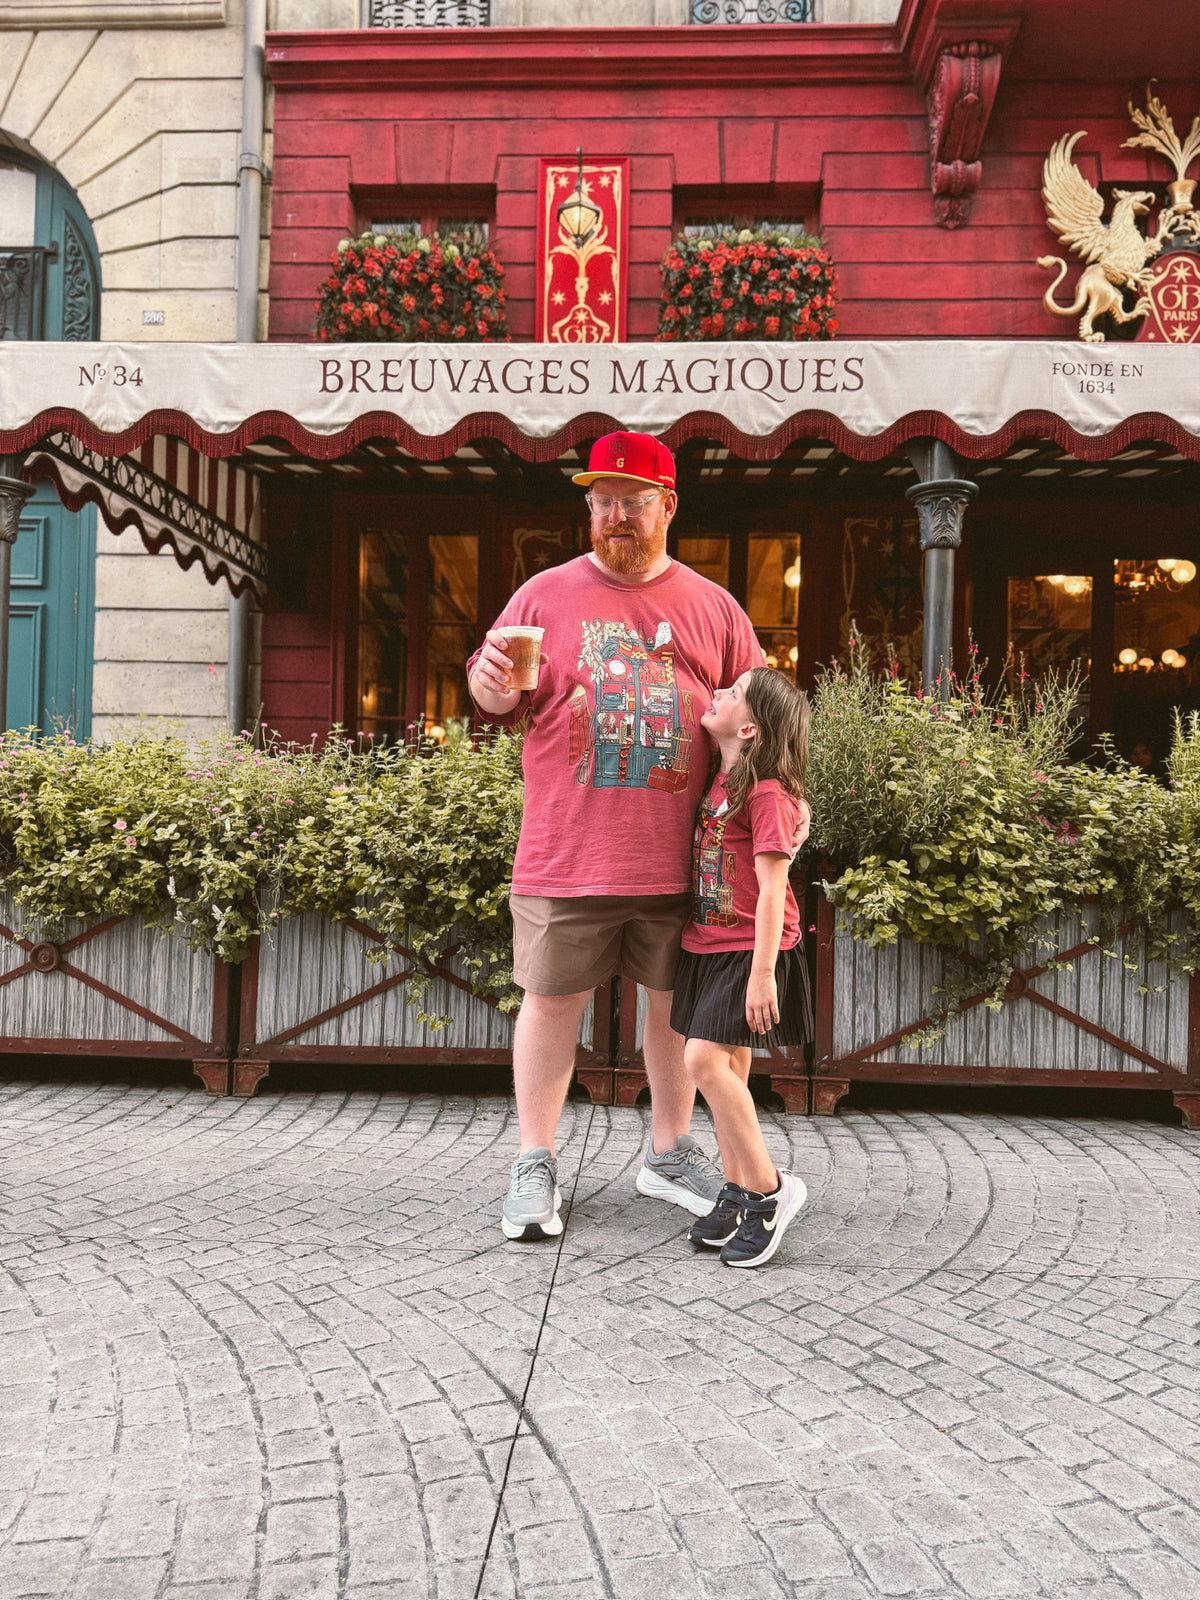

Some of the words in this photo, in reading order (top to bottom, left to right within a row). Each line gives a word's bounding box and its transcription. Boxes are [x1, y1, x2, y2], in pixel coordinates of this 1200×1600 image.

[1163, 311, 1199, 321] PARIS
[113, 365, 144, 387] 34
[1052, 361, 1114, 377] FONDÉ
[1120, 364, 1144, 377] EN
[318, 358, 591, 395] BREUVAGES
[608, 357, 865, 403] MAGIQUES
[1079, 380, 1116, 394] 1634
[616, 458, 625, 468] G
